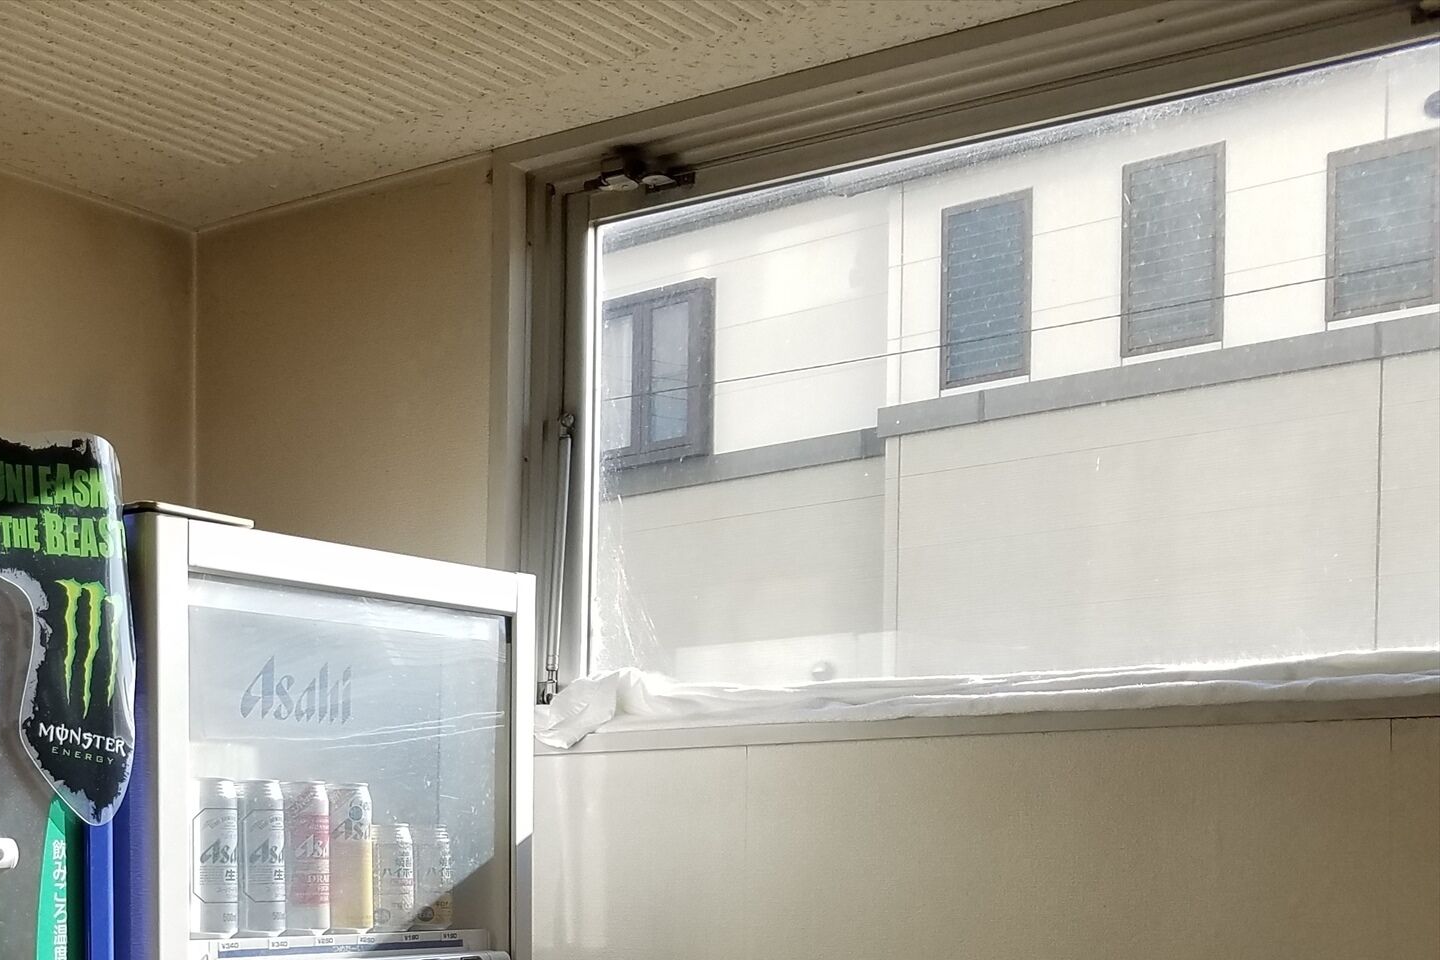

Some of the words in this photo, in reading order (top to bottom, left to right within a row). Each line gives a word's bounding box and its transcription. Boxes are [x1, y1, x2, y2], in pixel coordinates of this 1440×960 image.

[44, 512, 127, 559] BEAST
[239, 655, 354, 726] Asahi
[38, 721, 127, 758] MONSTER
[51, 745, 115, 766] ENERGY
[224, 868, 237, 882] 生
[273, 868, 285, 881] 生
